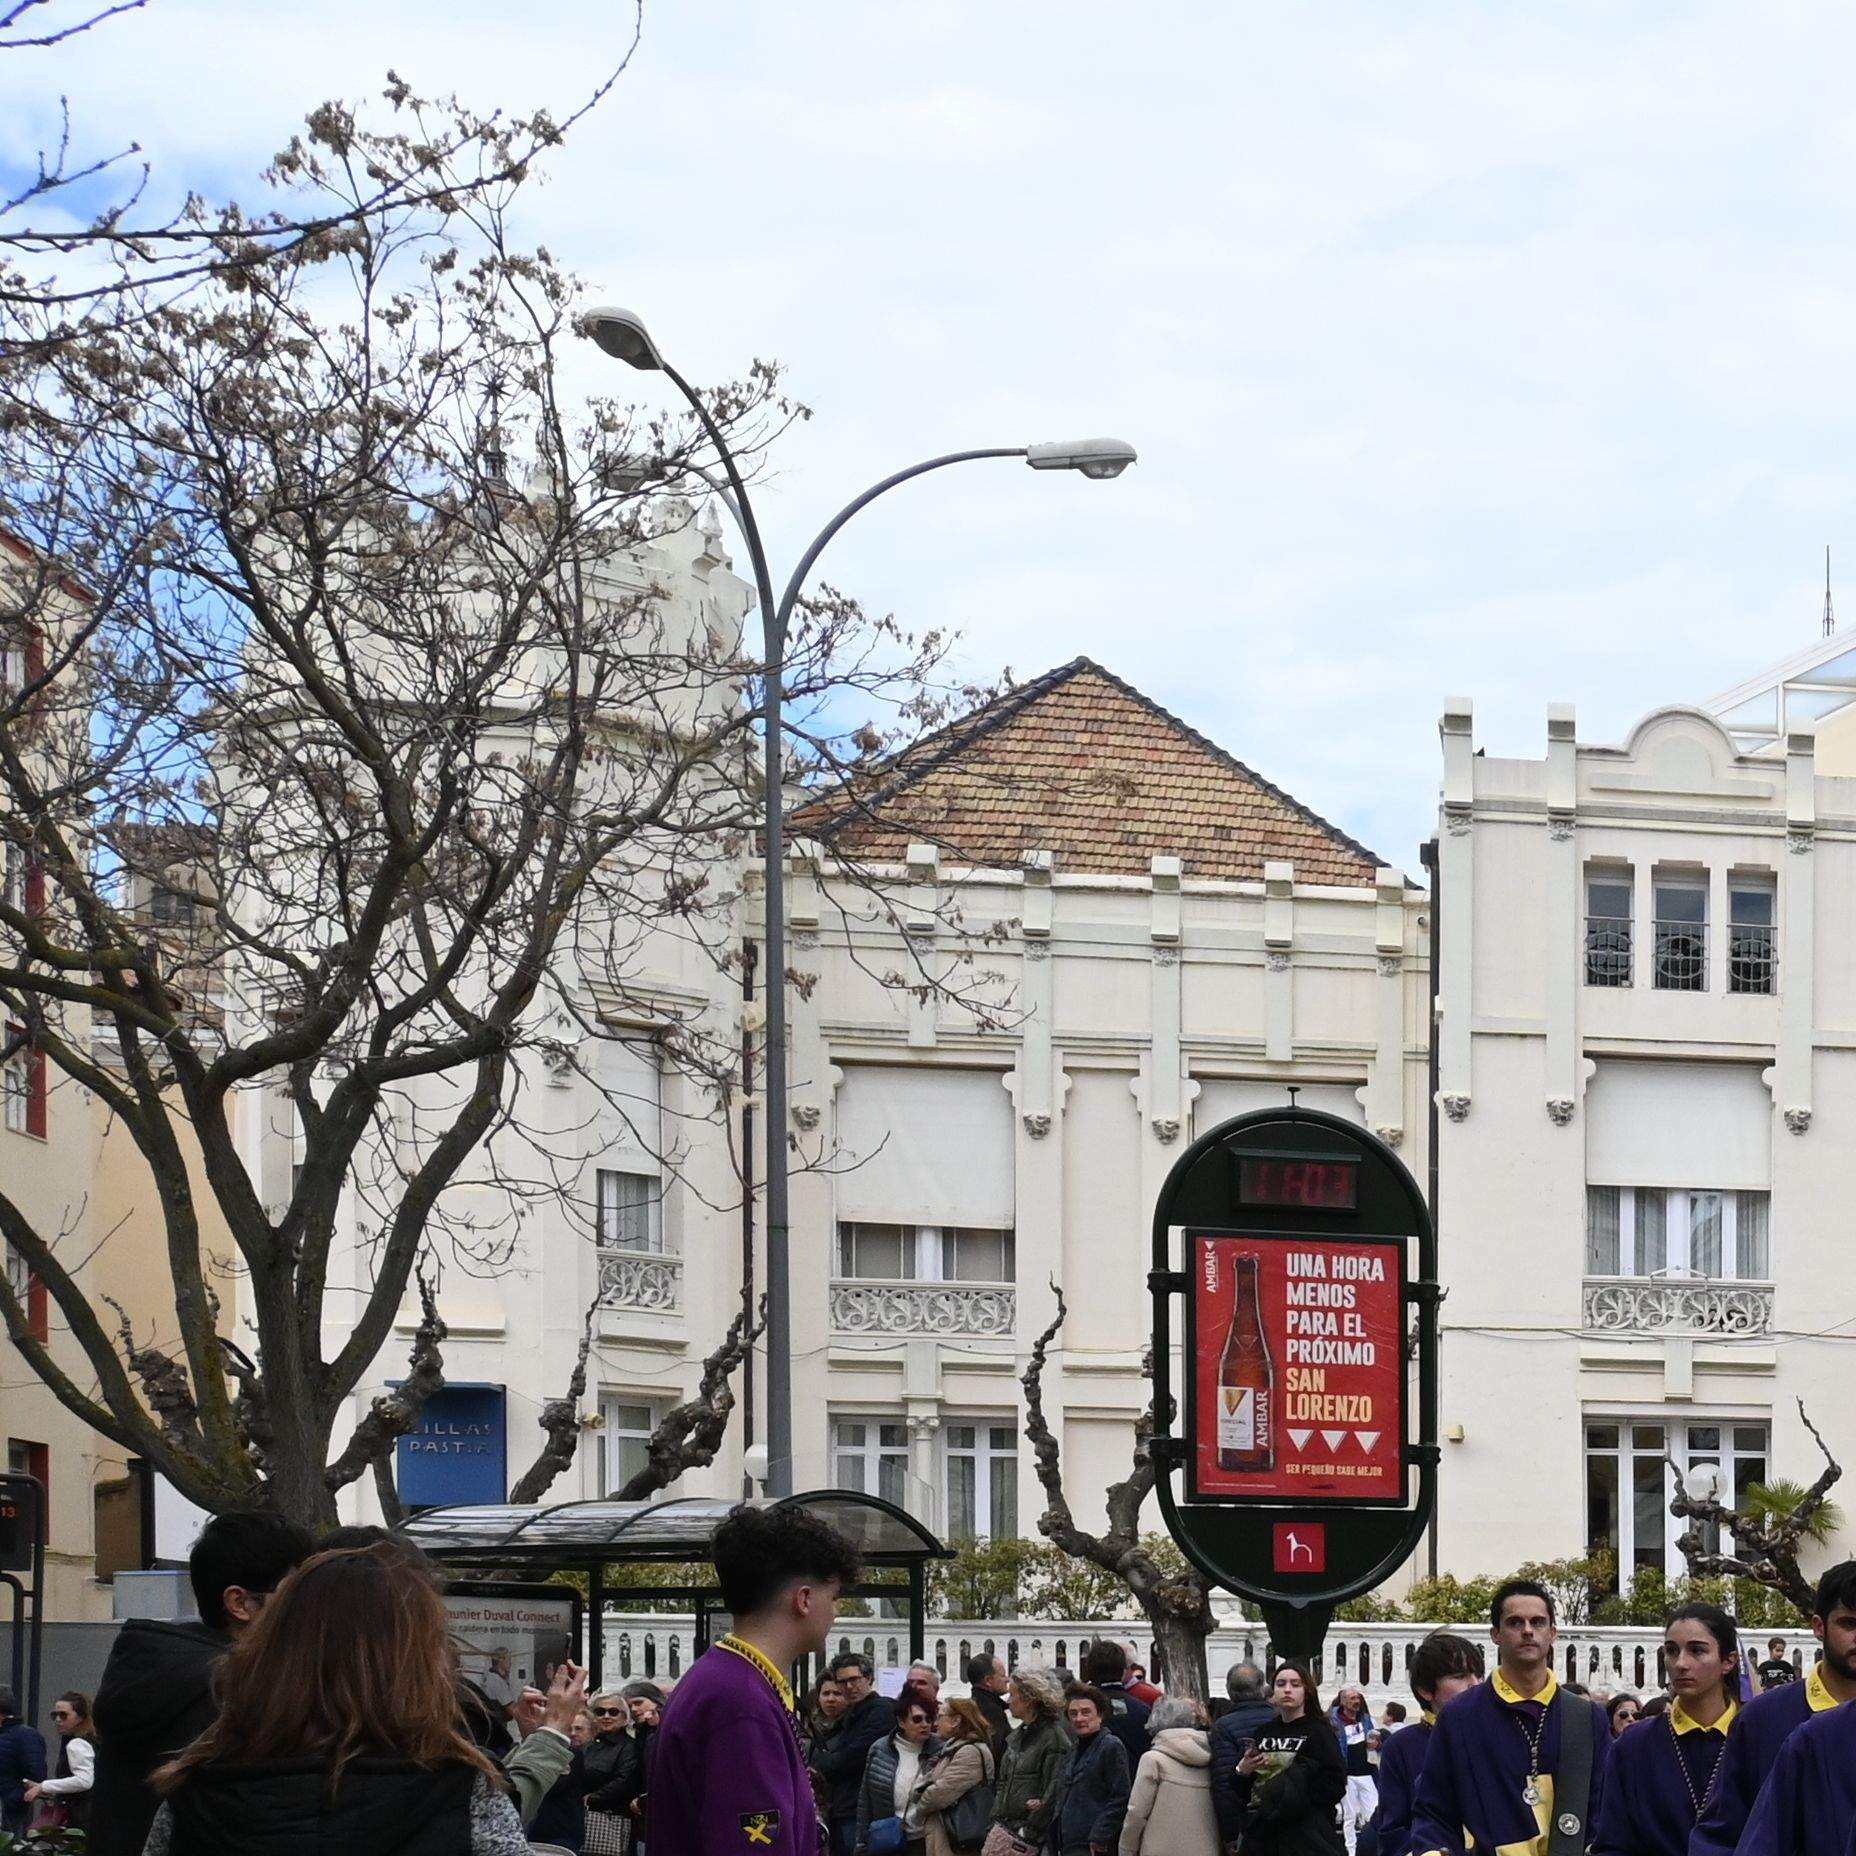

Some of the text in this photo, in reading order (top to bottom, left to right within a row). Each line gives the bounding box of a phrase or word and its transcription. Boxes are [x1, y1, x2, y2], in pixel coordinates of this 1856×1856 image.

[1205, 1250, 1217, 1294] AMBAR
[1286, 1253, 1385, 1282] UNA HORA
[1286, 1281, 1356, 1309] MENOS
[1286, 1310, 1367, 1338] PARA EL
[1286, 1336, 1375, 1366] PRÓXIMO
[1285, 1367, 1326, 1392] SAN
[1255, 1390, 1269, 1447] AMBAR
[1286, 1393, 1373, 1423] LORENZO
[413, 1423, 492, 1435] ILLAS
[483, 1609, 514, 1622] Duval
[516, 1610, 561, 1623] Connect
